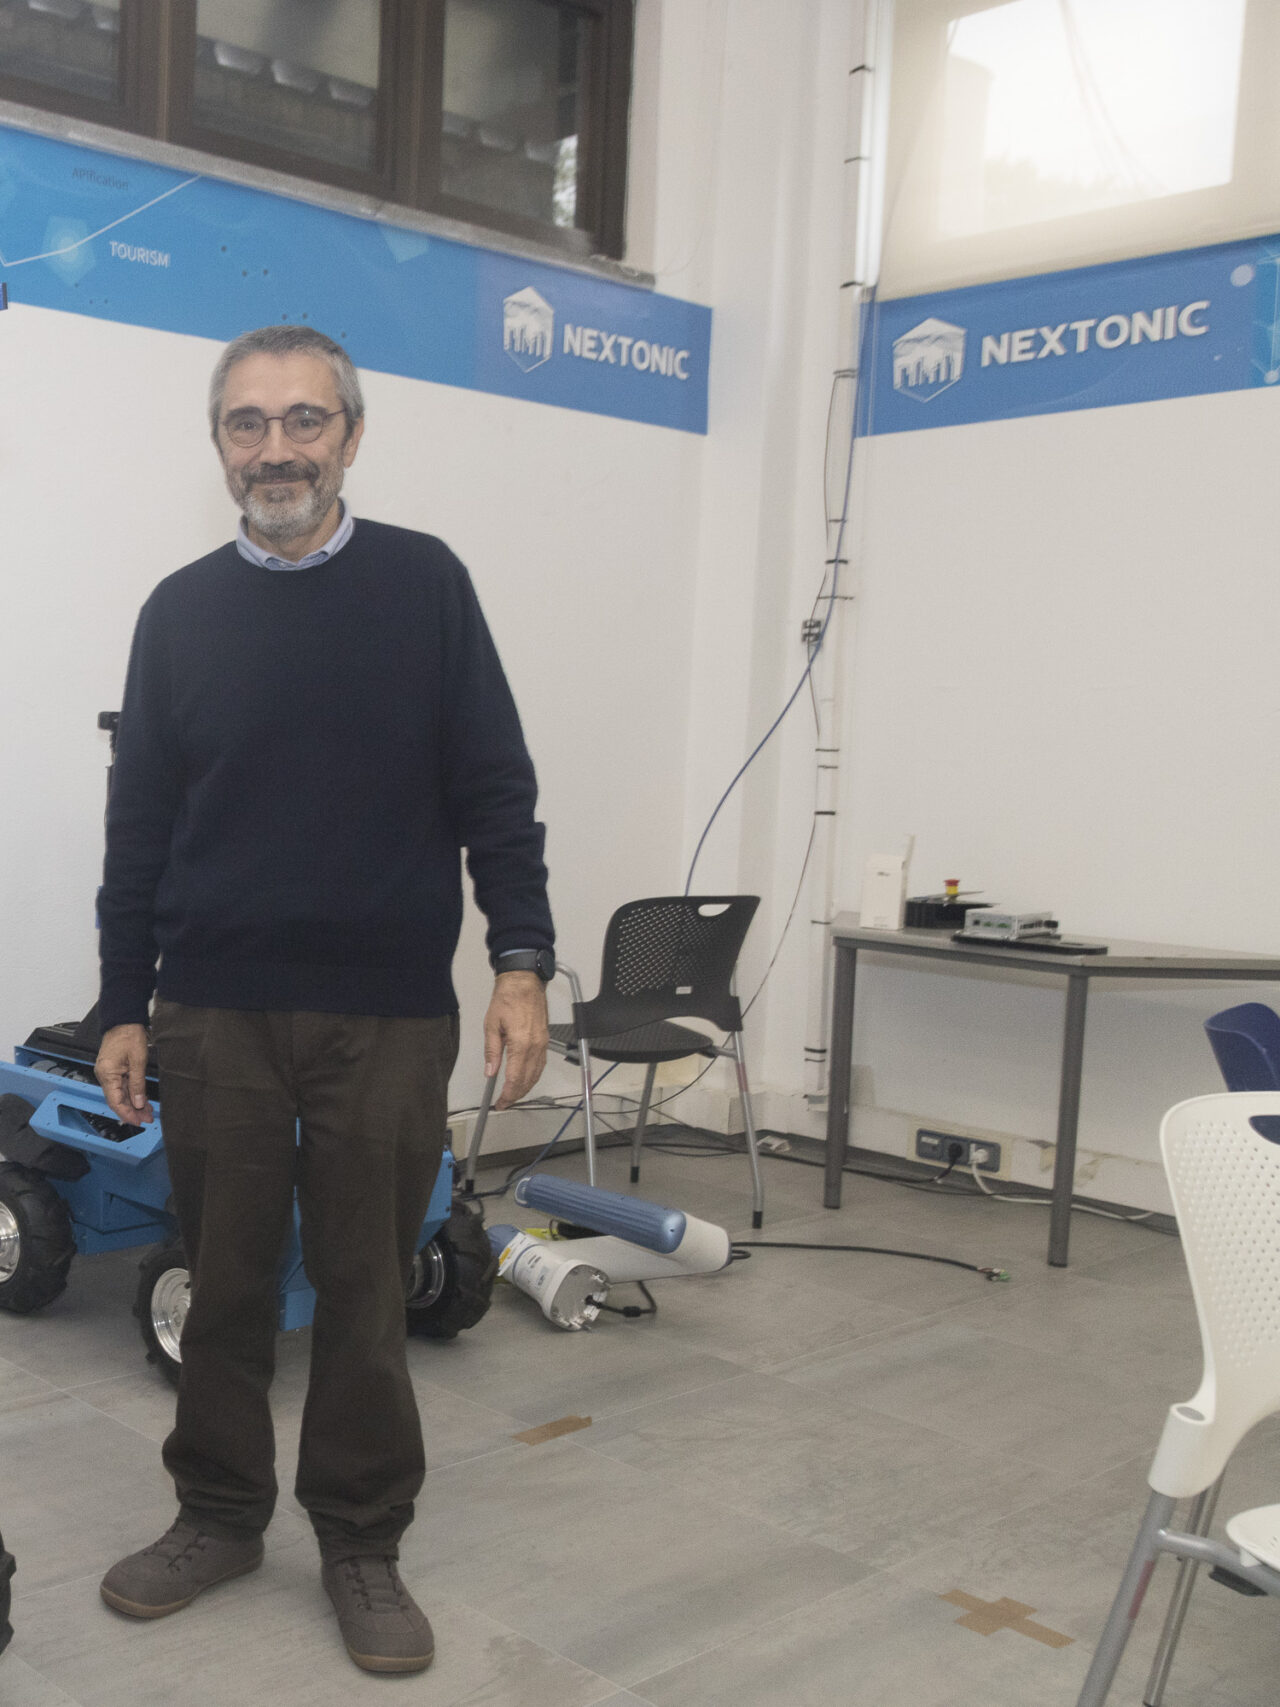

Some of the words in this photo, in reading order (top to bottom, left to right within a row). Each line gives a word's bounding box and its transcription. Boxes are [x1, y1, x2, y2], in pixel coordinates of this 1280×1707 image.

[109, 240, 170, 268] TOURISM
[563, 322, 690, 381] NEXTONIC
[981, 299, 1211, 368] NEXTONIC
